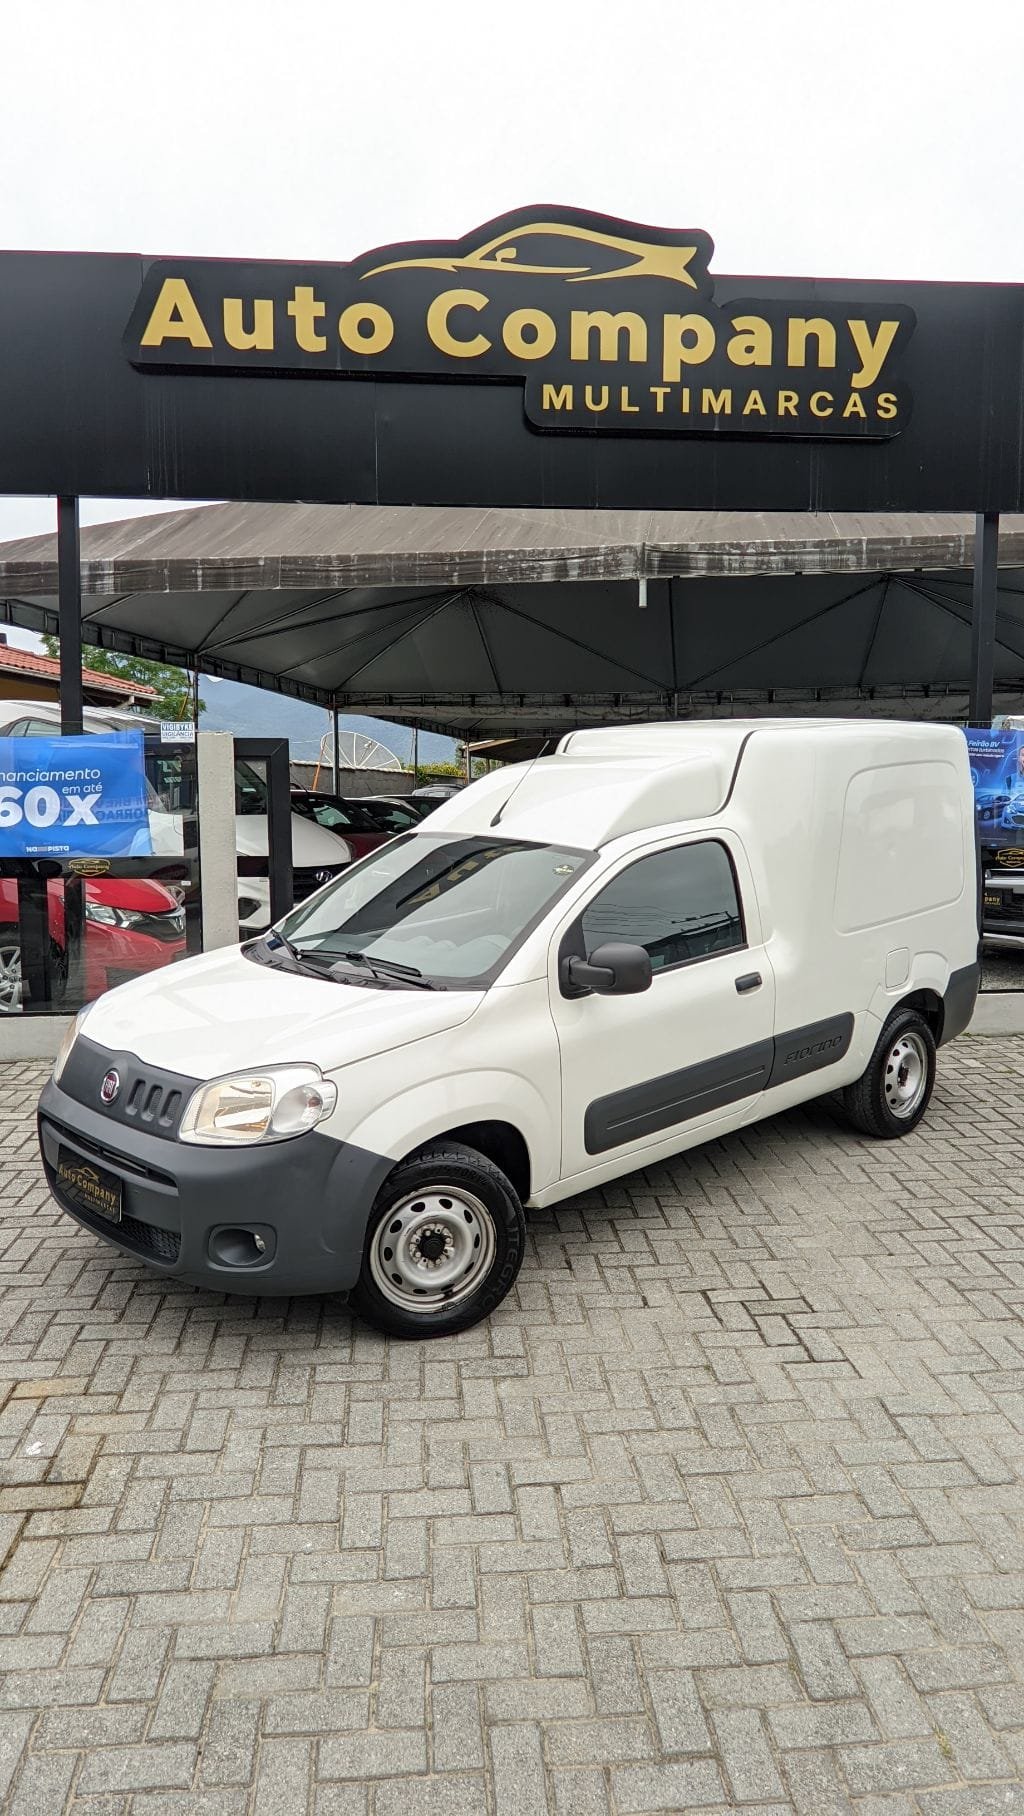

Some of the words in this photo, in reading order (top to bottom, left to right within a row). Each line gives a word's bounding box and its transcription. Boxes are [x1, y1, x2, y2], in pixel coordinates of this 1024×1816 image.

[141, 279, 394, 355] Auto
[427, 290, 898, 389] Company
[543, 384, 898, 419] MULTIMARCAS
[0, 785, 102, 828] 60x
[62, 786, 80, 794] em
[83, 782, 103, 793] até
[58, 1163, 76, 1182] Auto
[77, 1174, 116, 1206] Company
